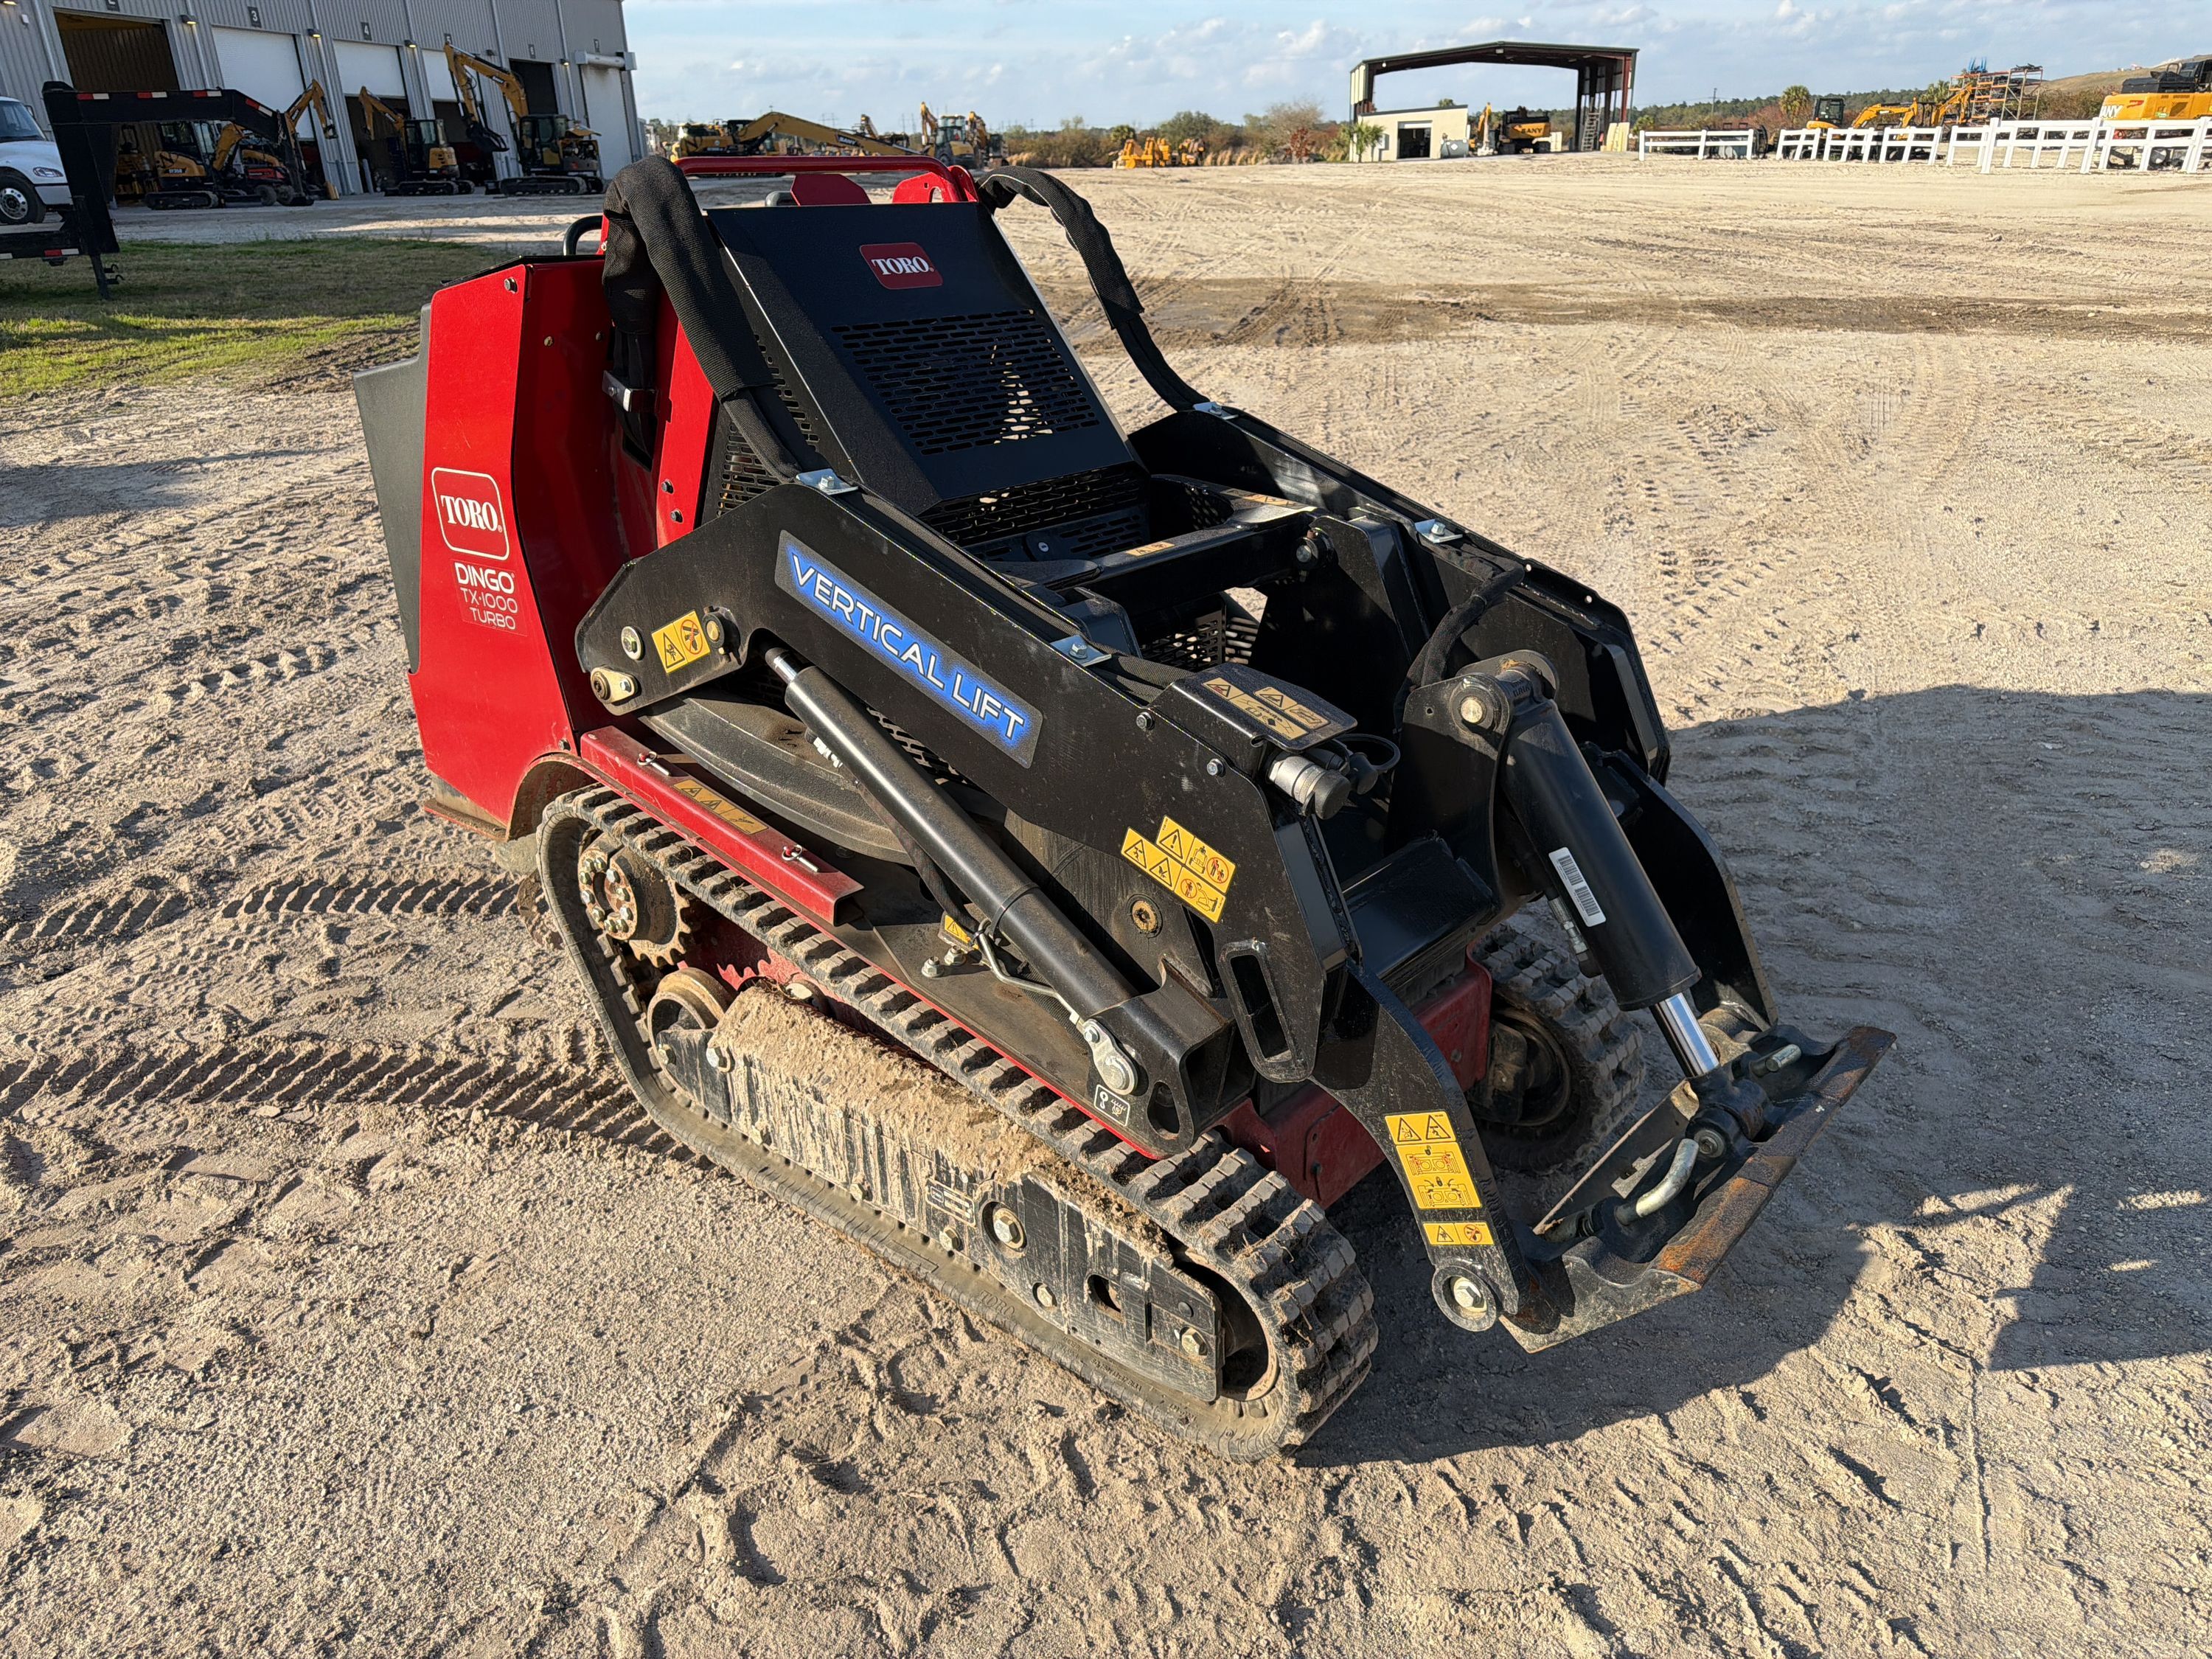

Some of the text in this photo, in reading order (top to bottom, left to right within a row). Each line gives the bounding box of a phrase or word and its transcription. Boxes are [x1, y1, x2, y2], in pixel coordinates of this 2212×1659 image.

[251, 10, 258, 21] 3
[364, 24, 369, 35] 4
[871, 256, 930, 276] TORO
[440, 494, 498, 532] TORO
[454, 562, 515, 594] DINGO
[469, 606, 516, 630] TURBO
[792, 554, 1024, 741] VERTICAL LIFT
[980, 1290, 1015, 1316] TORO
